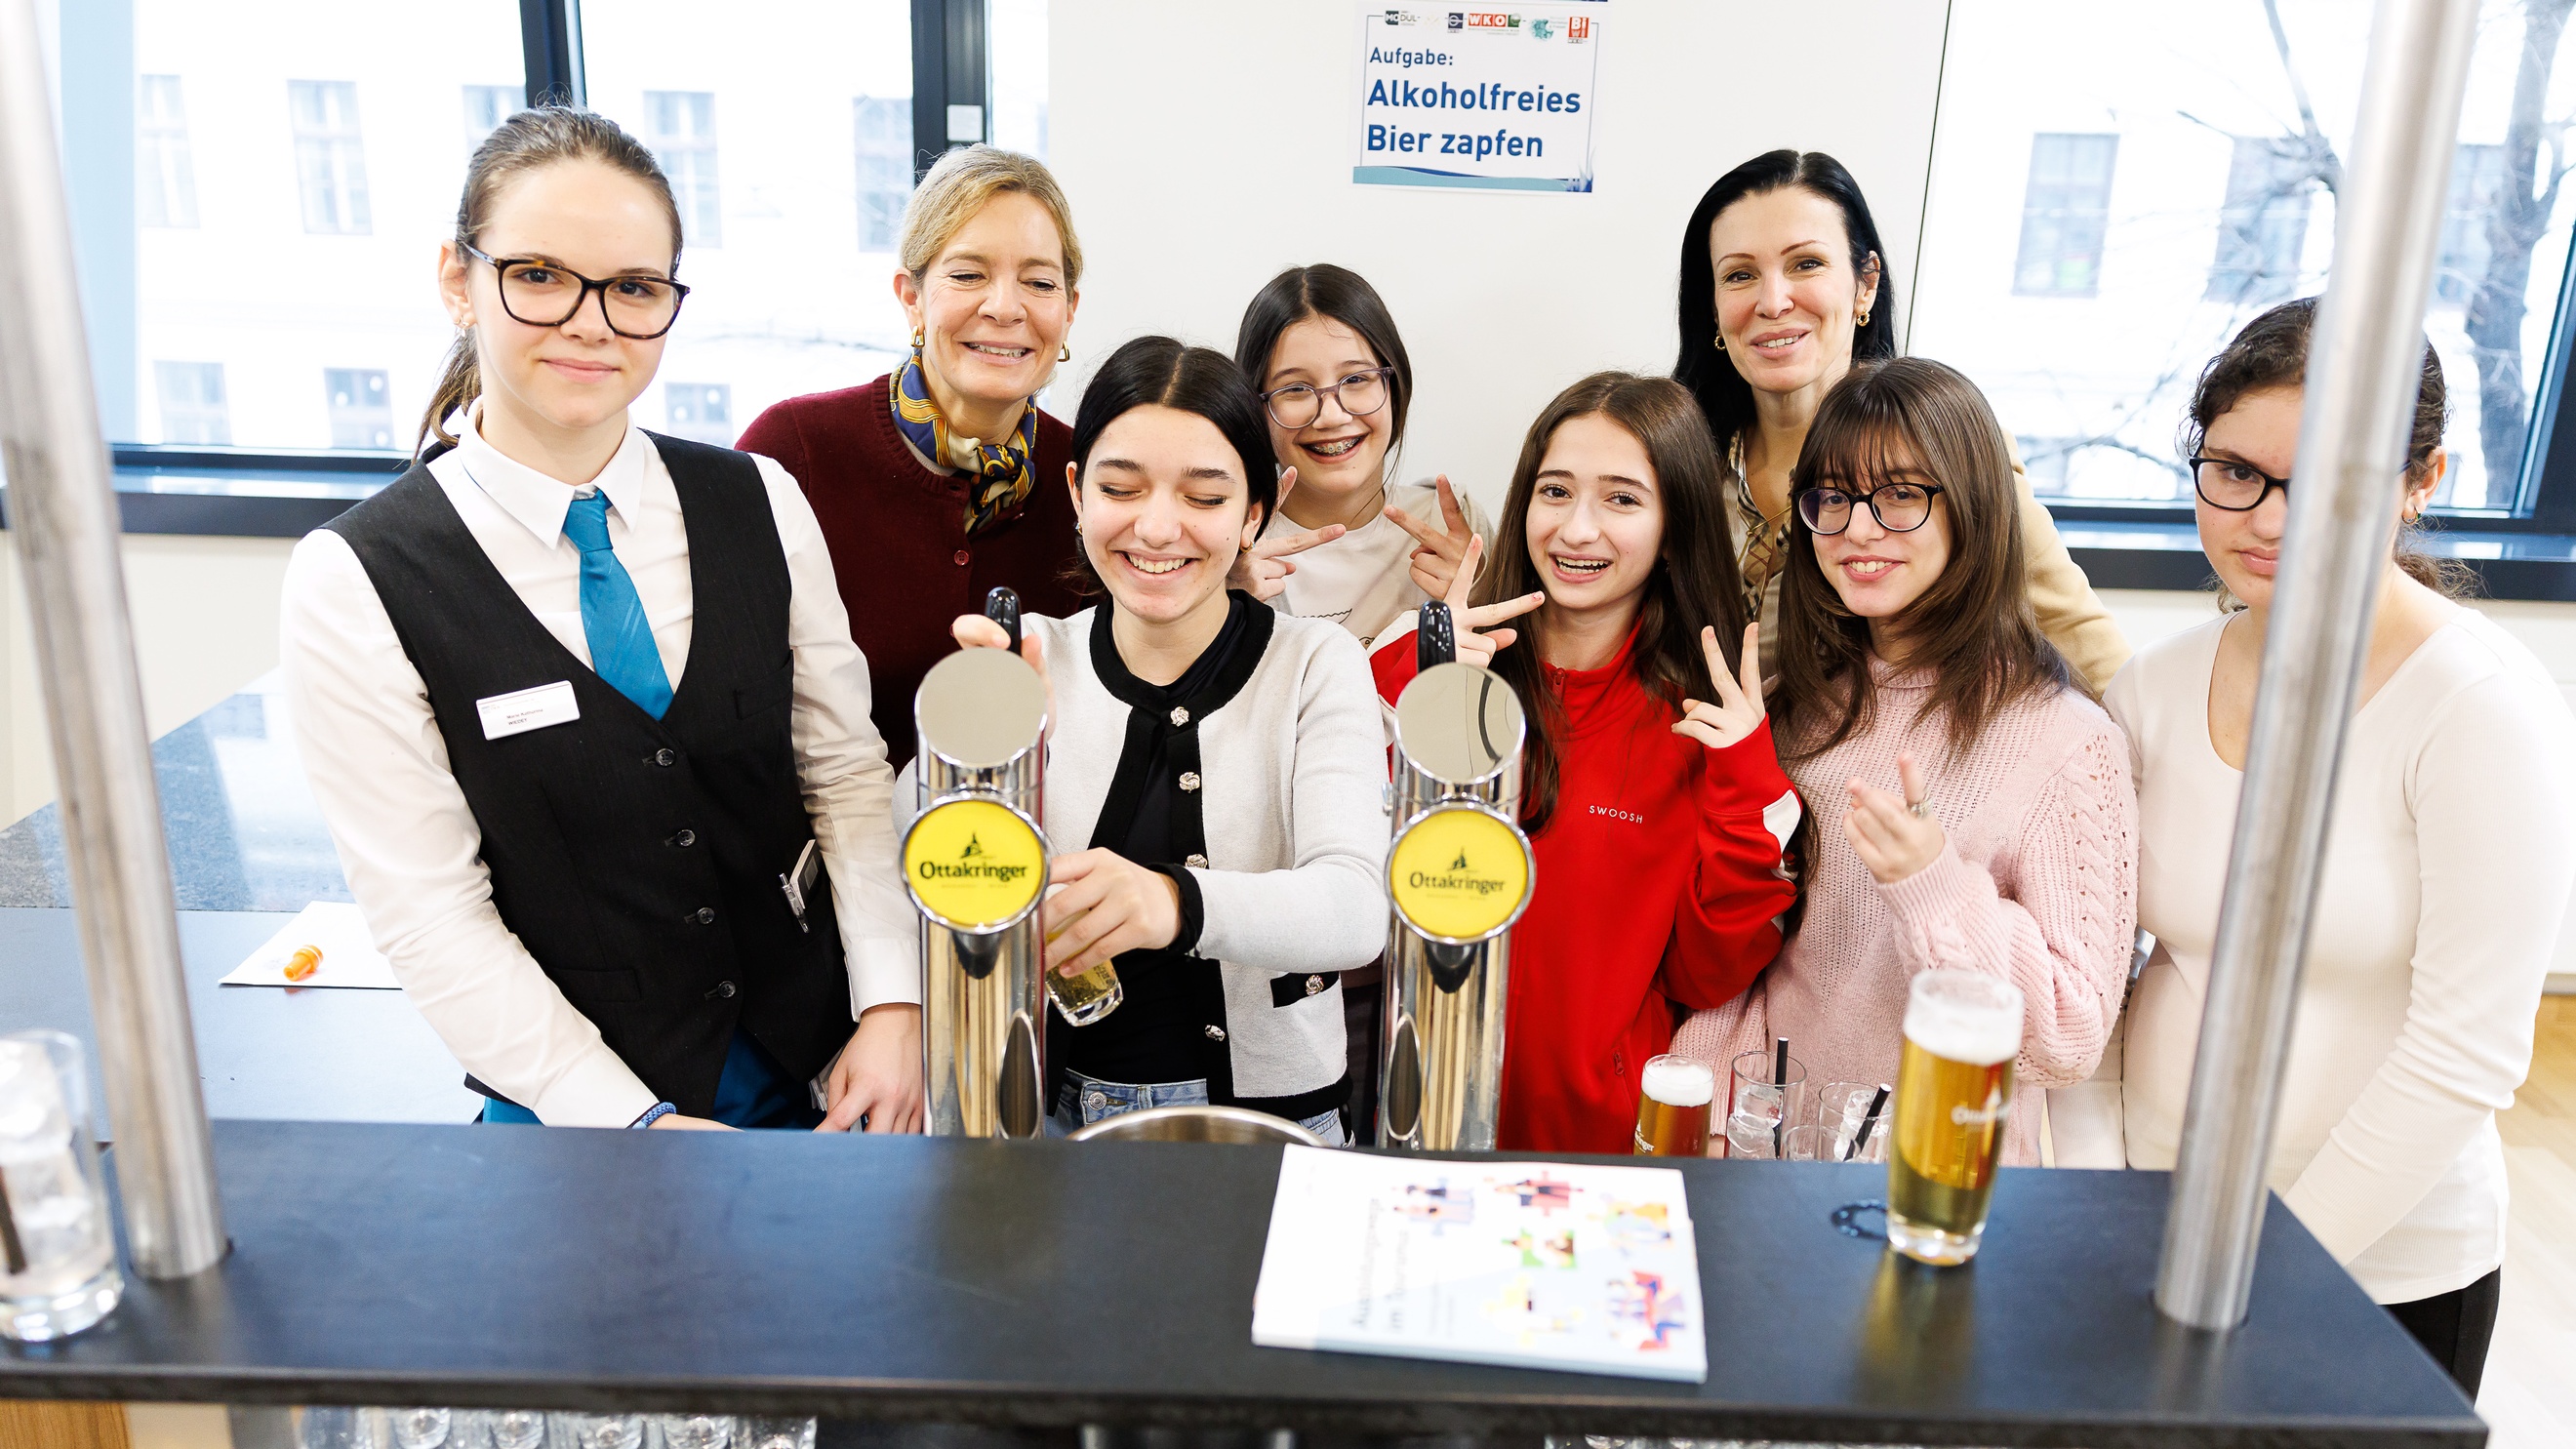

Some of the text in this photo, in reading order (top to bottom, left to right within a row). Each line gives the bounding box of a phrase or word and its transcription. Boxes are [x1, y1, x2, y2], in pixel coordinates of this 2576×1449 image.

[1469, 14, 1506, 26] WKO
[1369, 47, 1454, 68] Aufgabe:
[1367, 79, 1581, 113] Alkoholfreies
[1367, 124, 1544, 162] Bier zapfen
[1589, 805, 1643, 825] SWOOSH
[919, 861, 1027, 883] Ottakringer
[1410, 871, 1506, 895] Ottakringer
